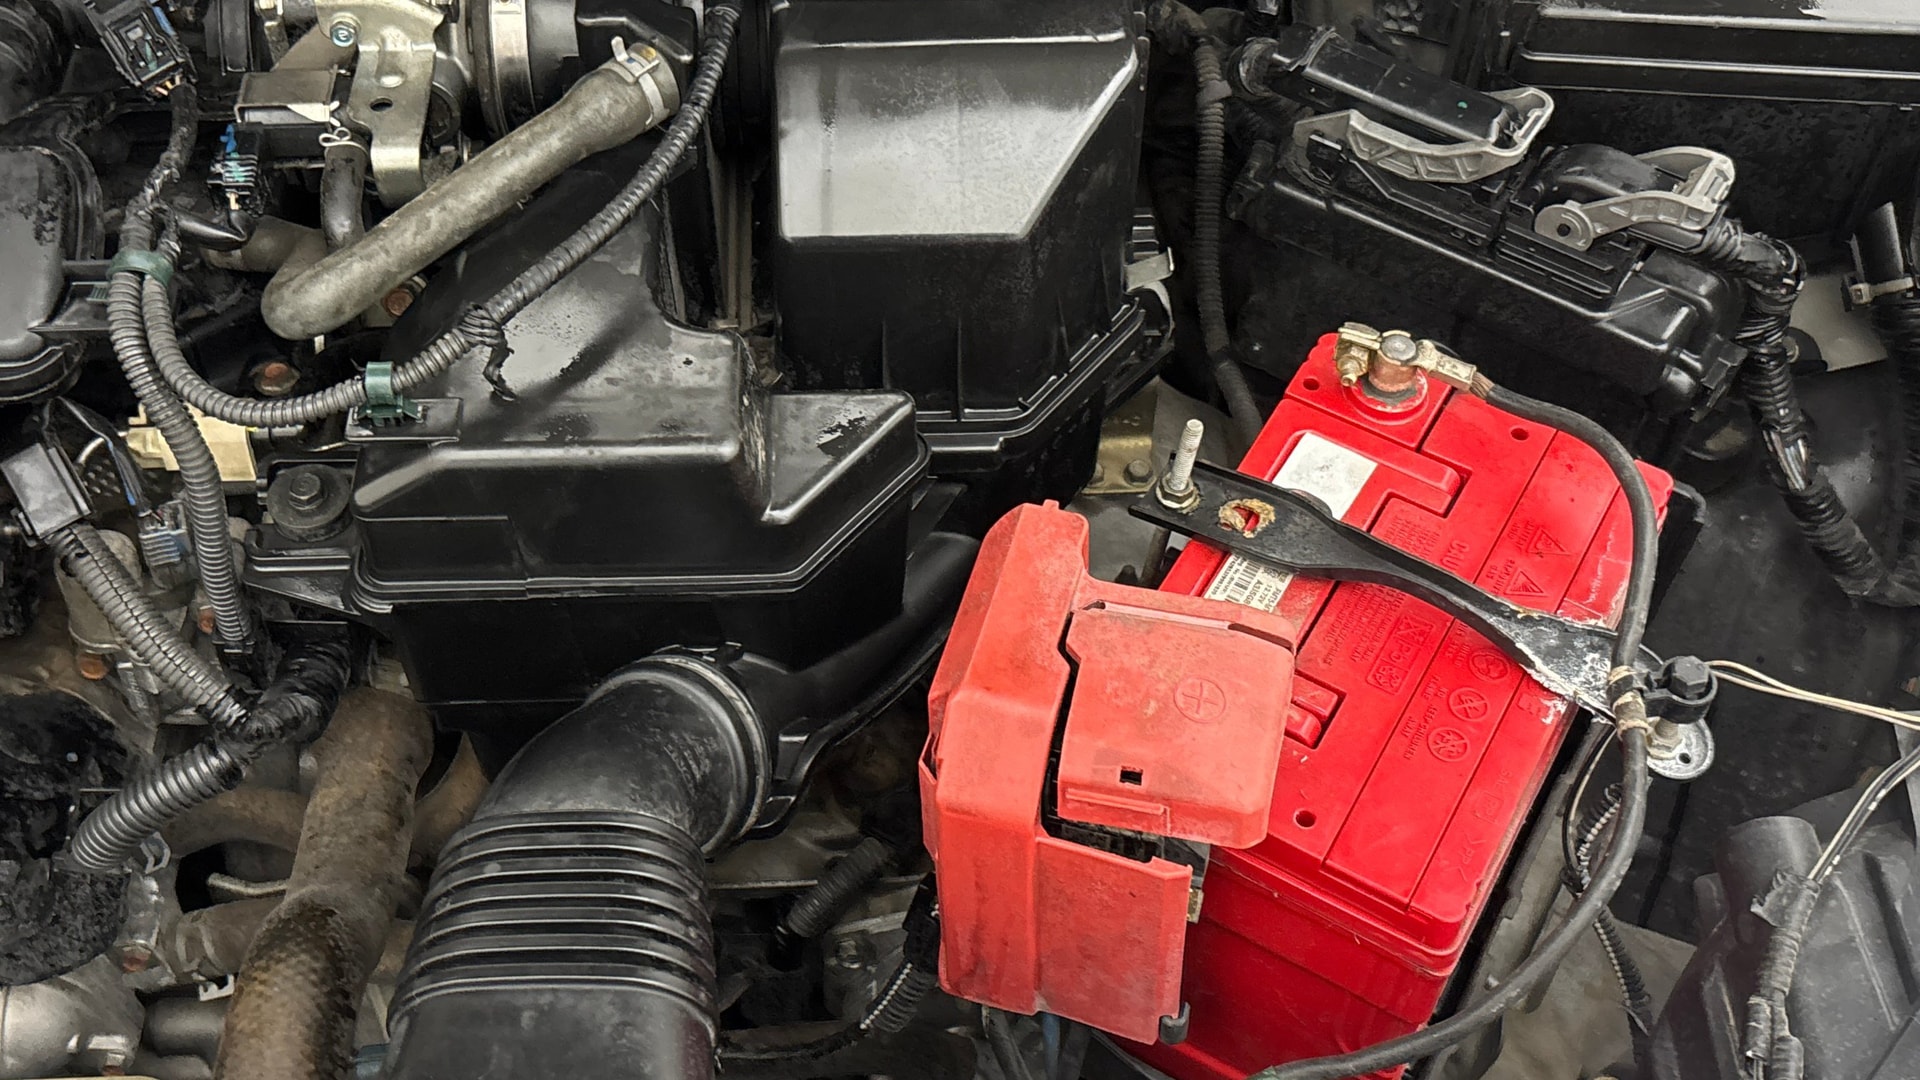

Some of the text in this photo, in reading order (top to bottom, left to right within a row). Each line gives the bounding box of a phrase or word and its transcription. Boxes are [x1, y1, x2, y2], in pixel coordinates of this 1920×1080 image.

[1387, 638, 1413, 666] Pb
[1419, 672, 1441, 701] FLAME
[1434, 684, 1449, 700] NO
